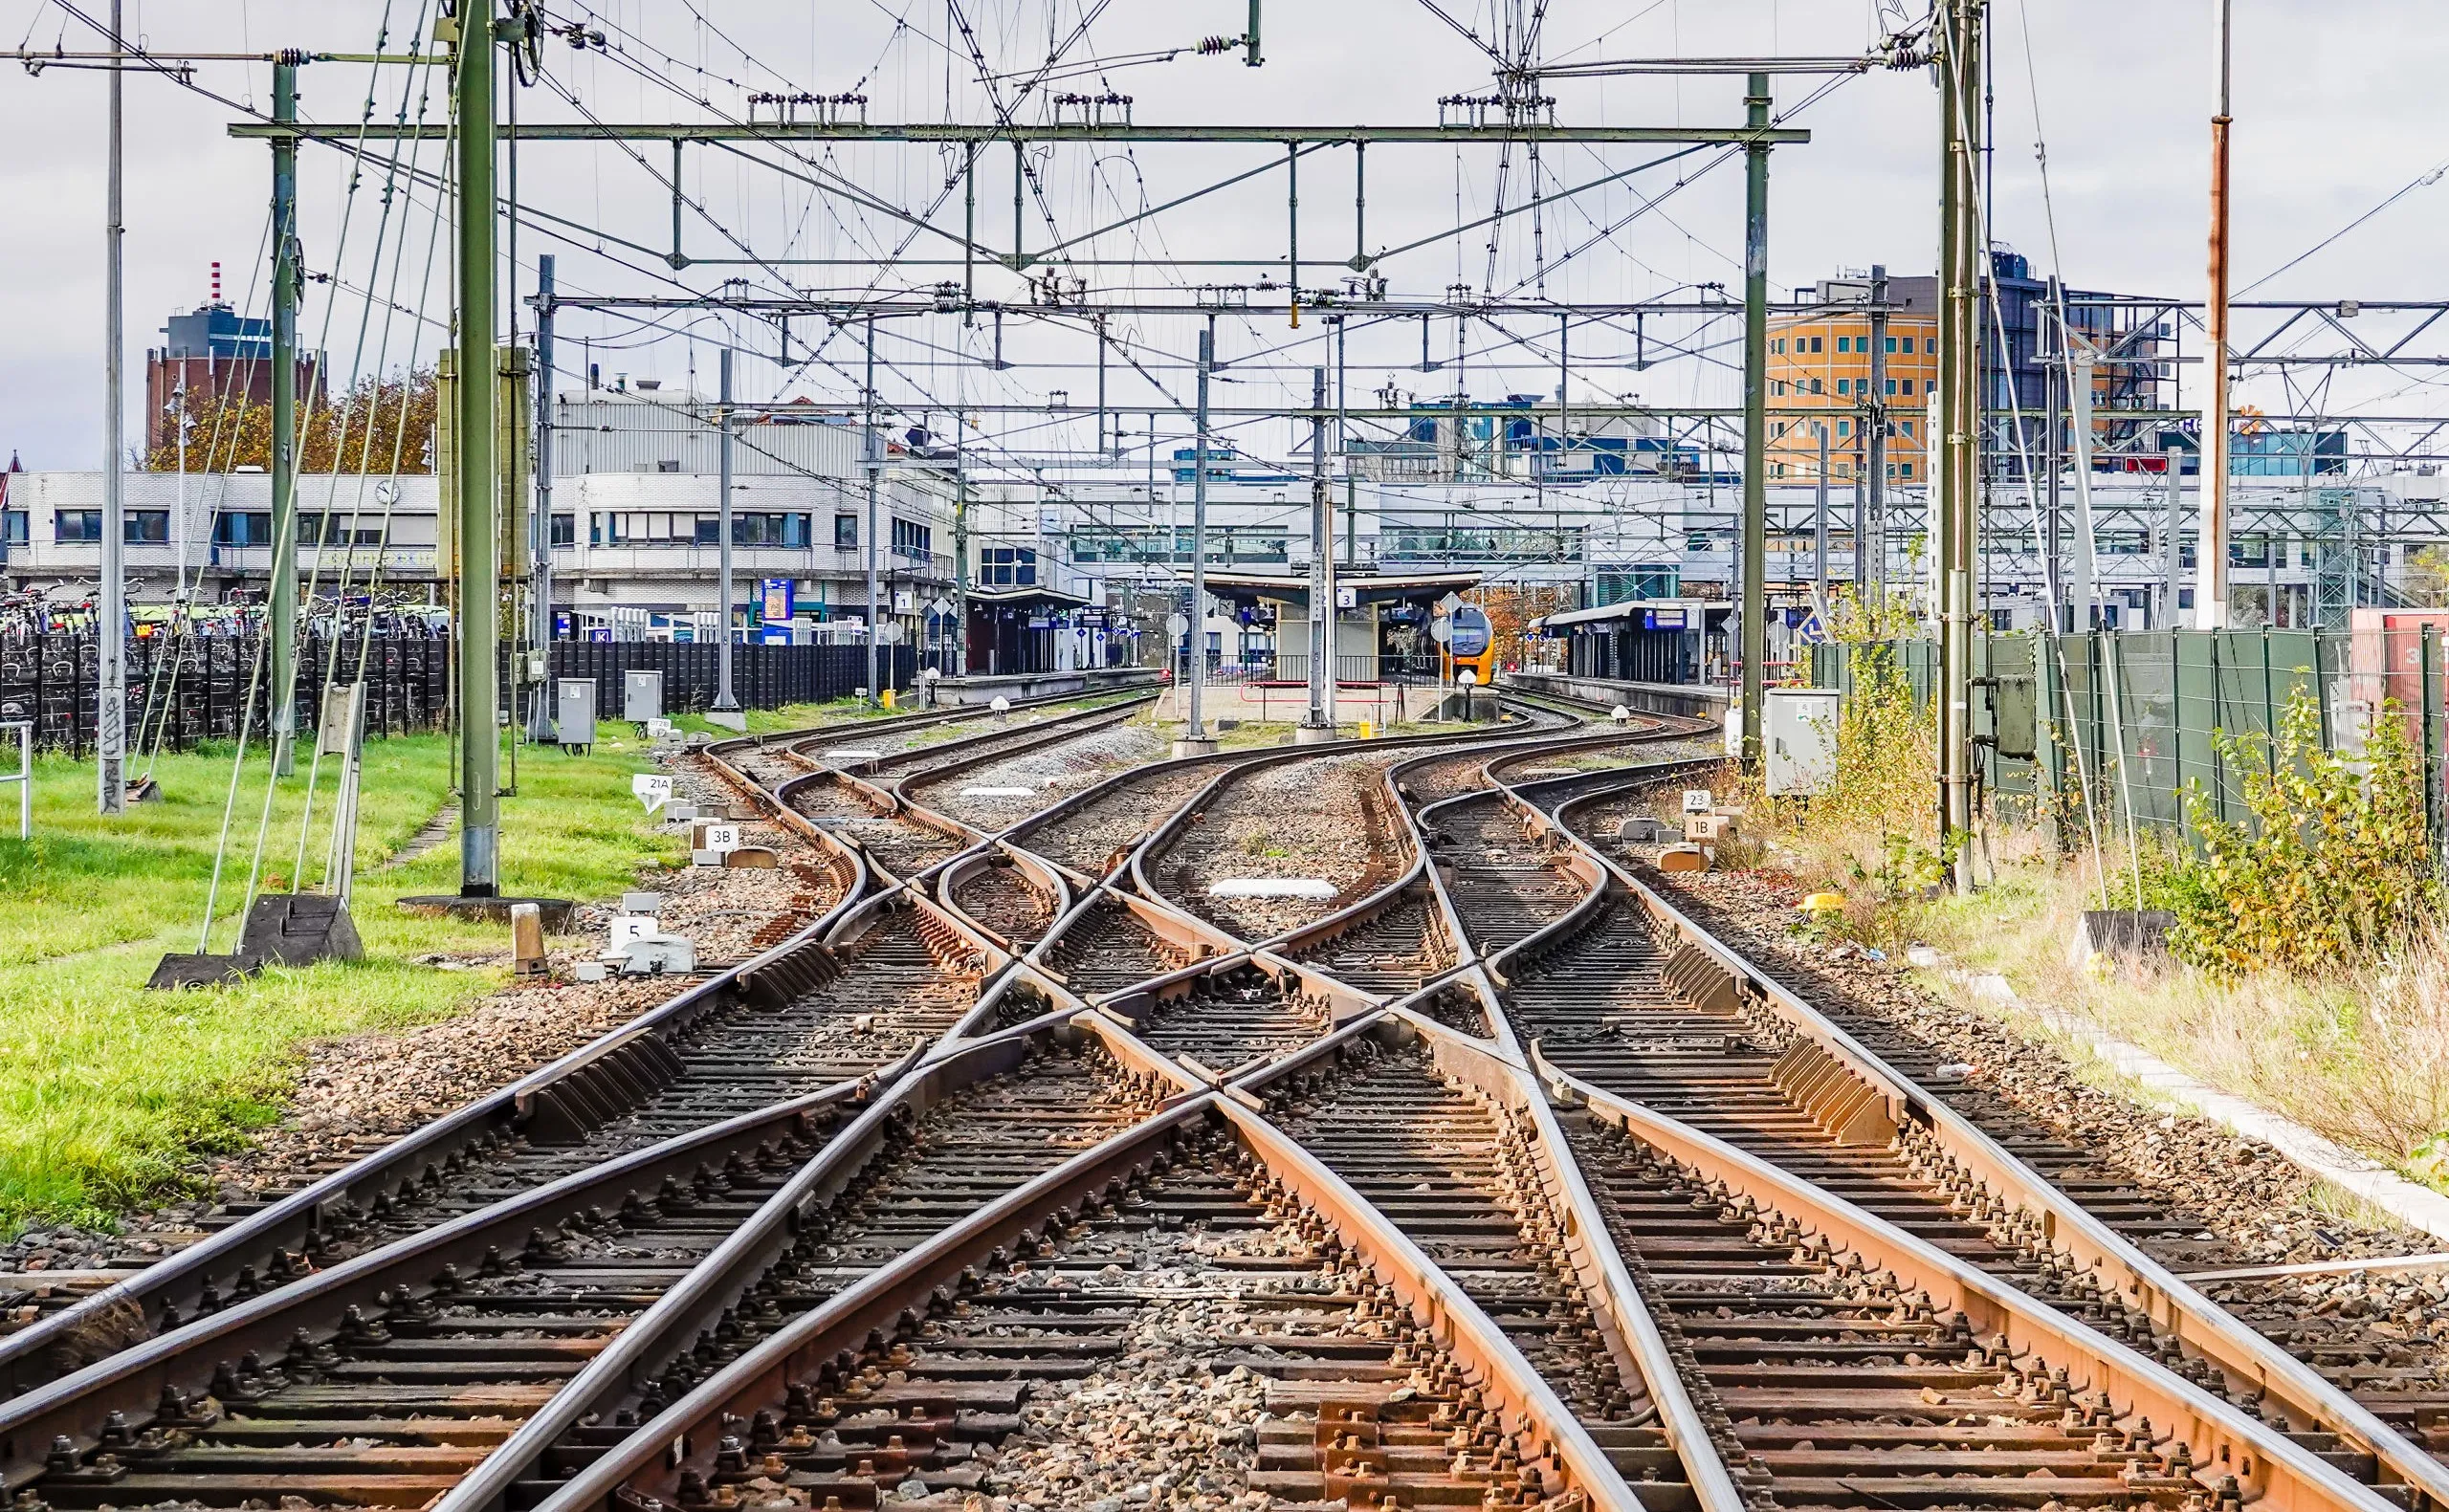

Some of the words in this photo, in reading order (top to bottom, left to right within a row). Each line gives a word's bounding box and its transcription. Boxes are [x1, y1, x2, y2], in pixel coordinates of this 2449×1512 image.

[901, 599, 906, 607] 1
[1343, 595, 1351, 605] 3
[1809, 623, 1821, 636] L
[598, 632, 607, 642] K
[2406, 647, 2420, 665] 3
[651, 778, 669, 789] 21A
[1690, 795, 1704, 805] 23
[1695, 822, 1709, 834] 1B
[714, 830, 731, 843] 3B
[629, 925, 640, 940] 5
